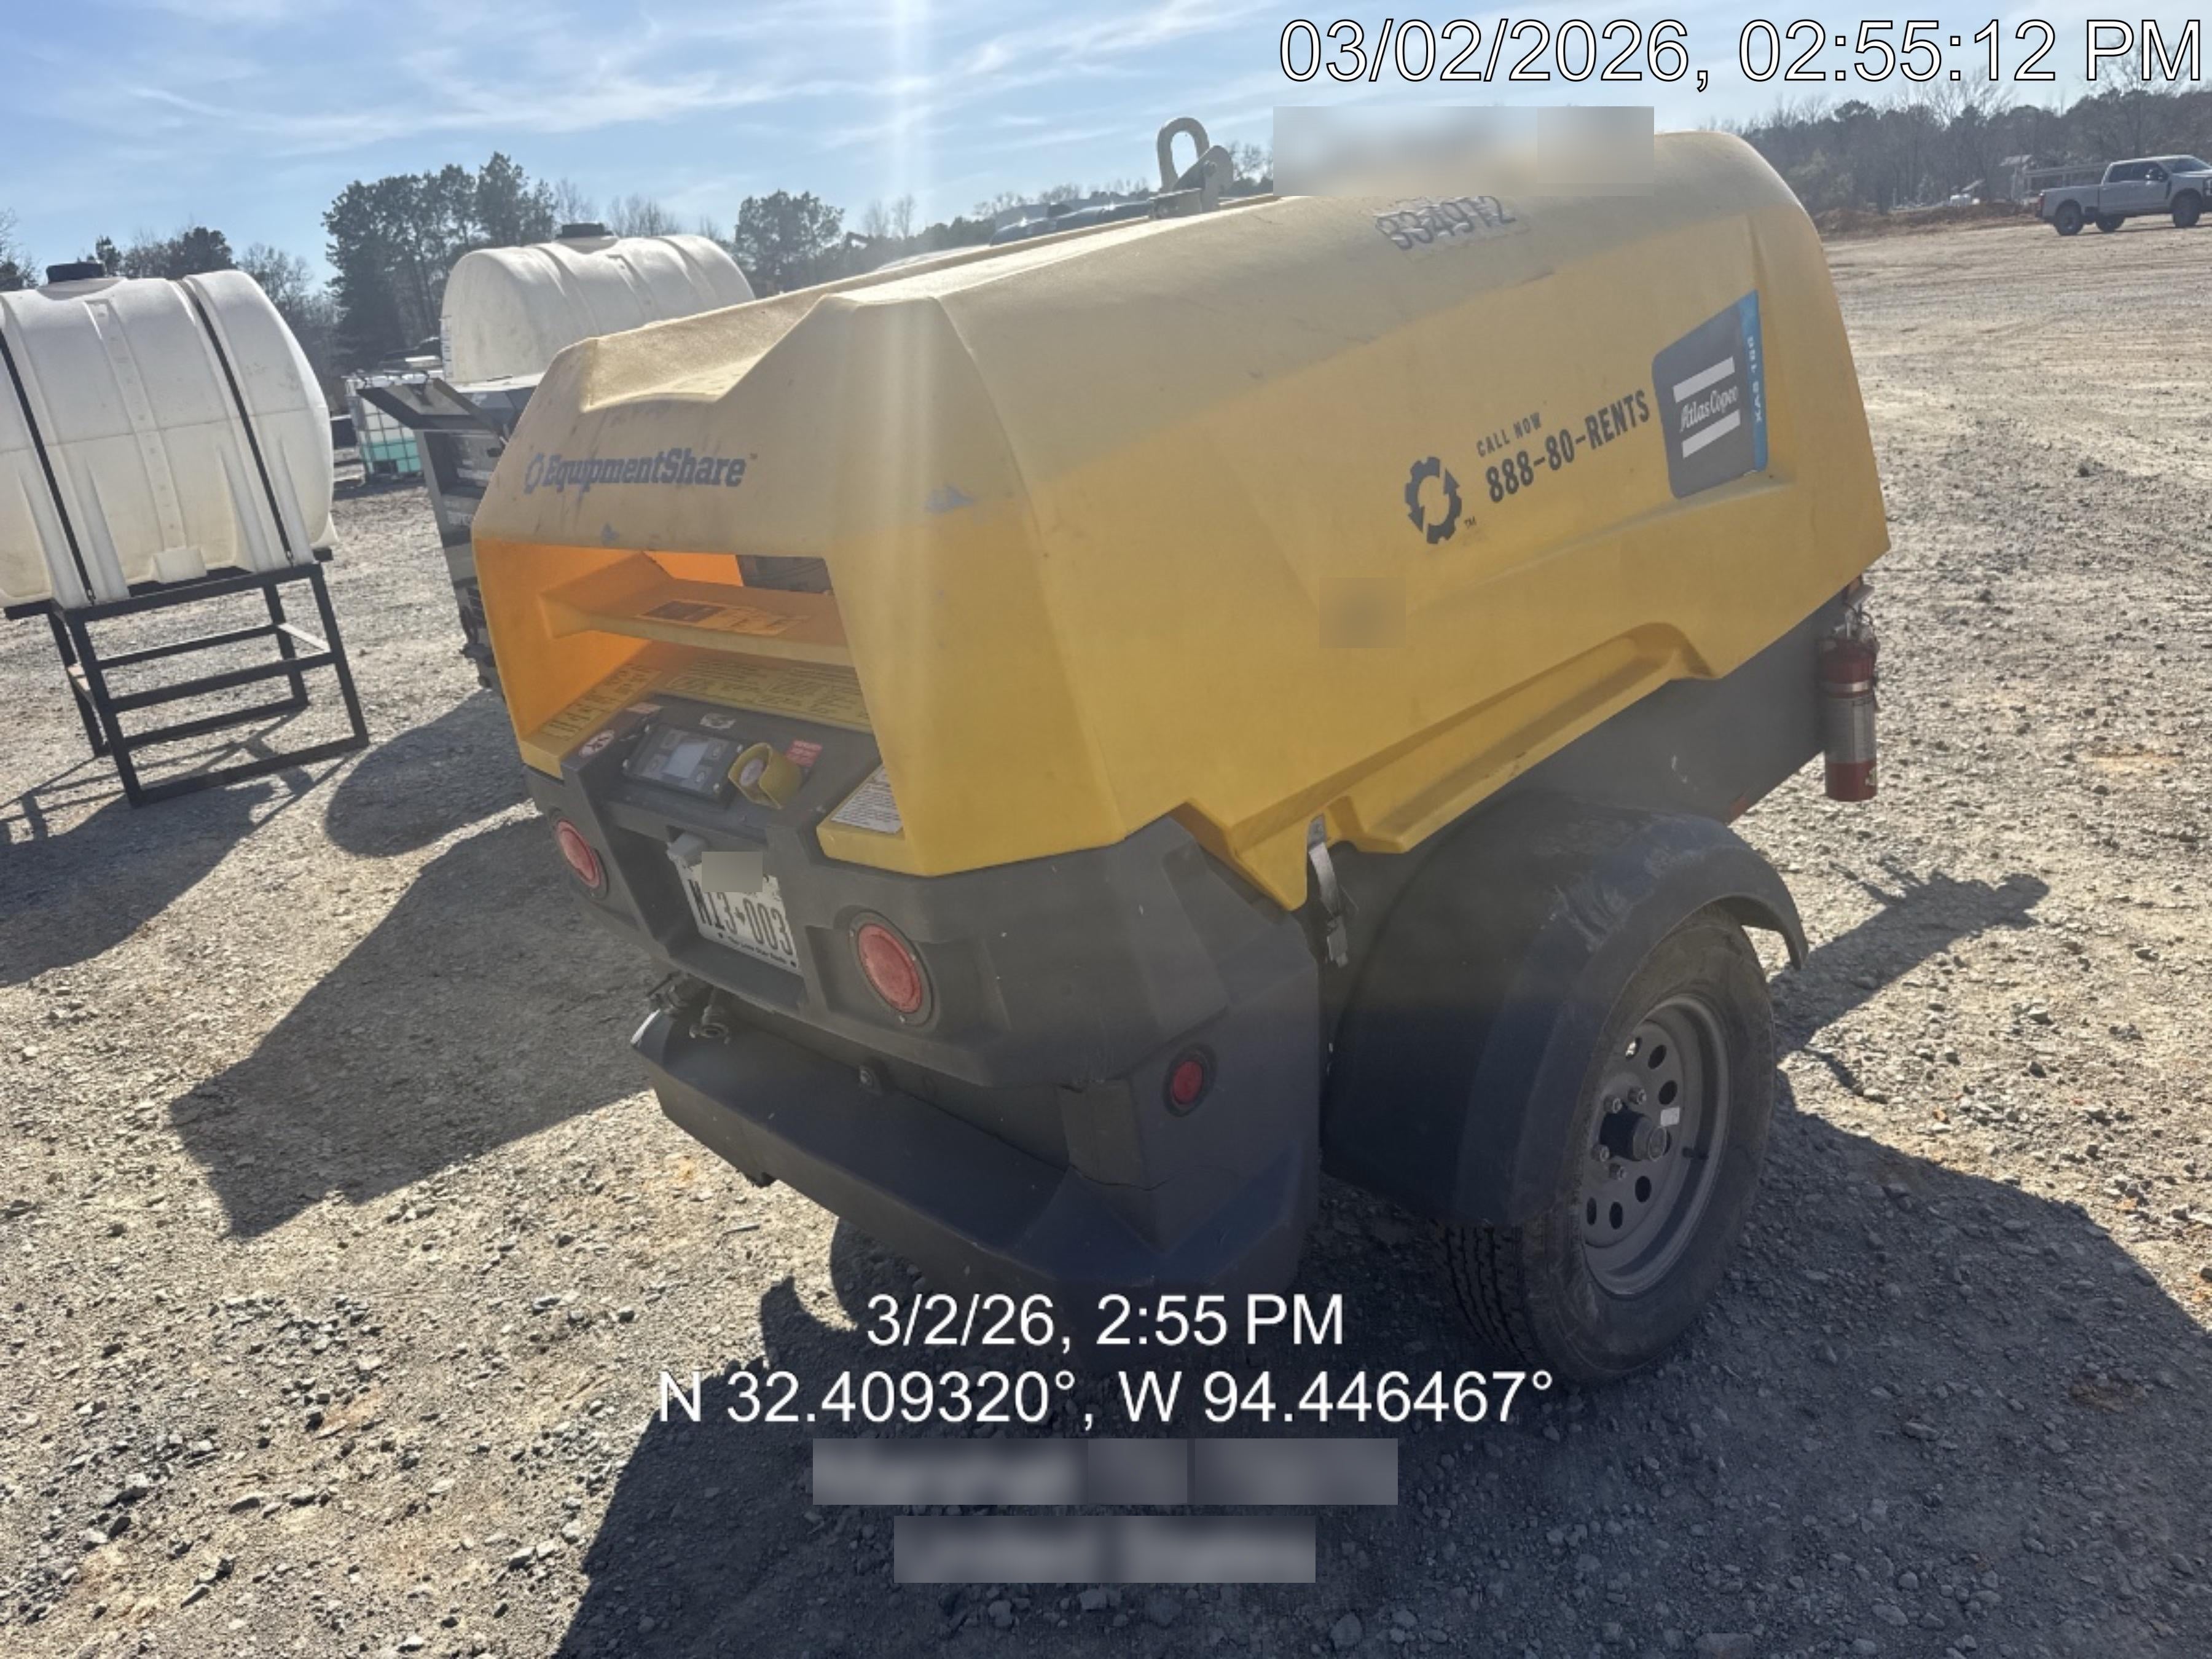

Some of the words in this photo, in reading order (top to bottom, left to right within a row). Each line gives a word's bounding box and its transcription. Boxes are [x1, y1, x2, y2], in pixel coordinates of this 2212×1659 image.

[1476, 429, 1510, 457] CALL
[1513, 412, 1542, 439] NOW
[1486, 389, 1650, 503] 888-80-RENTS
